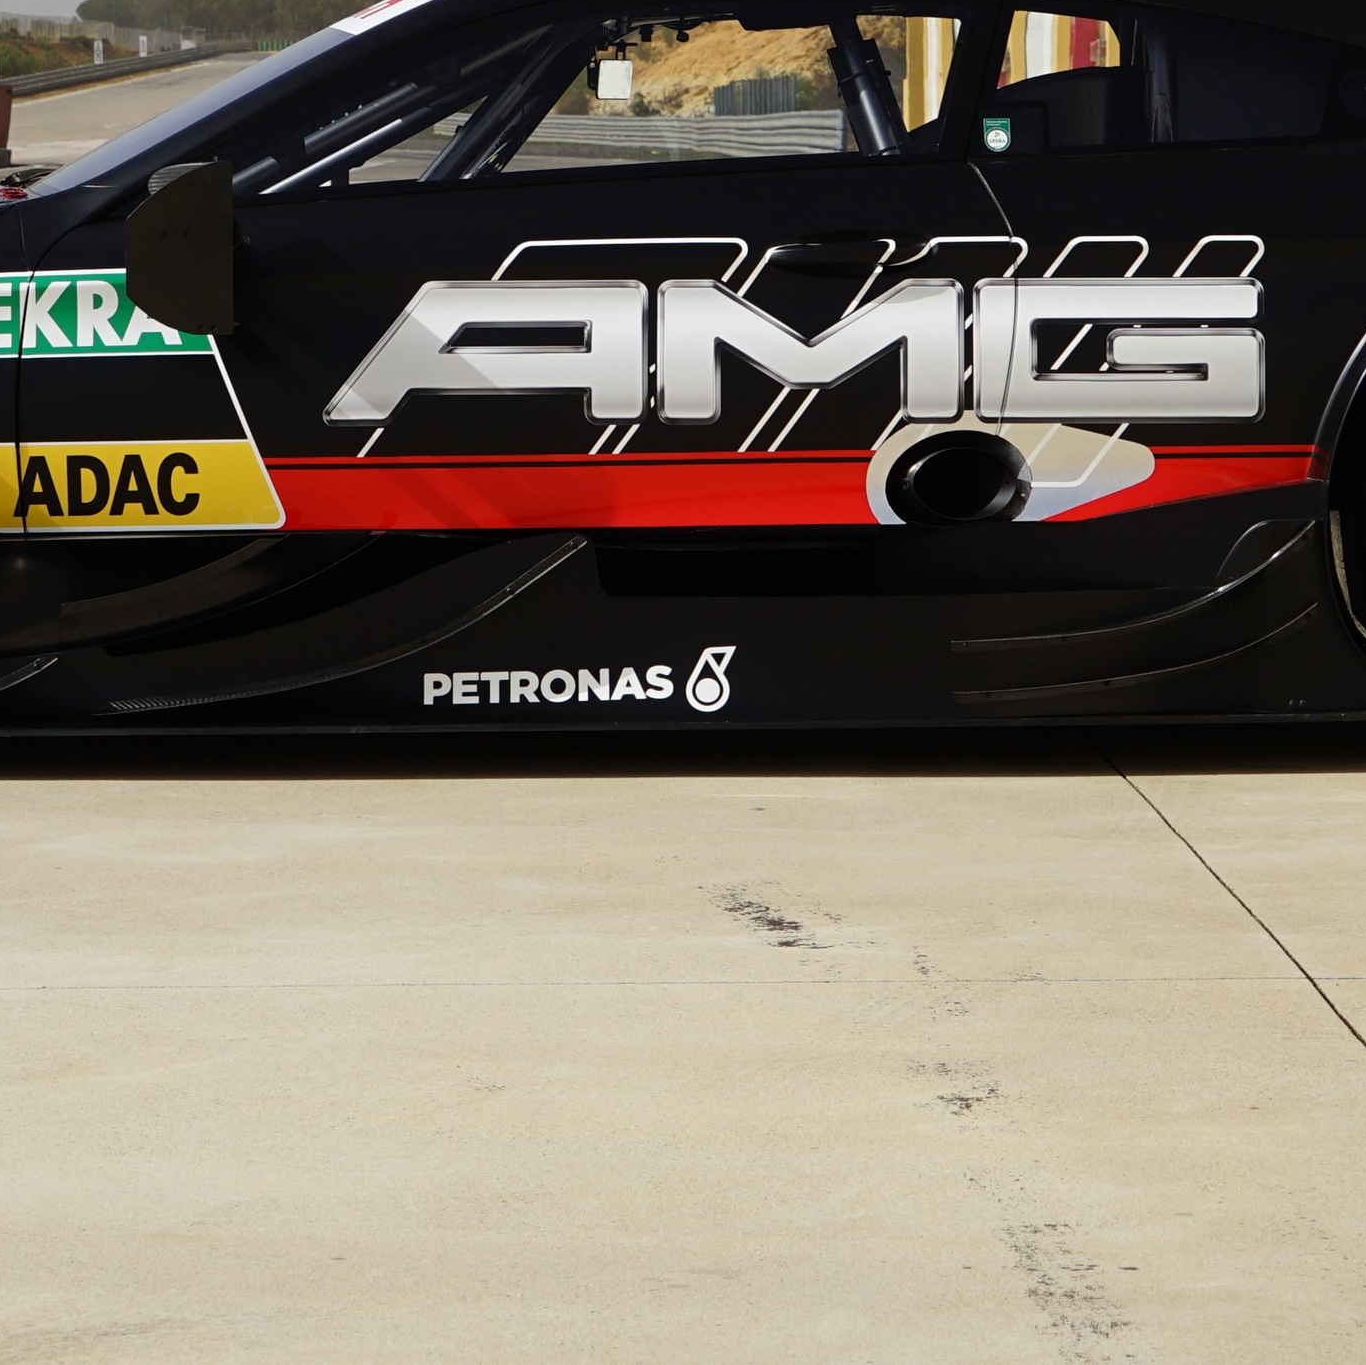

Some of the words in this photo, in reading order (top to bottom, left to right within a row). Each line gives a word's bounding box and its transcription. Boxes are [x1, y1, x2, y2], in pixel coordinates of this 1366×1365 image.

[322, 277, 1265, 425] AMG
[13, 452, 200, 517] ADAC
[423, 665, 674, 705] PETRONAS
